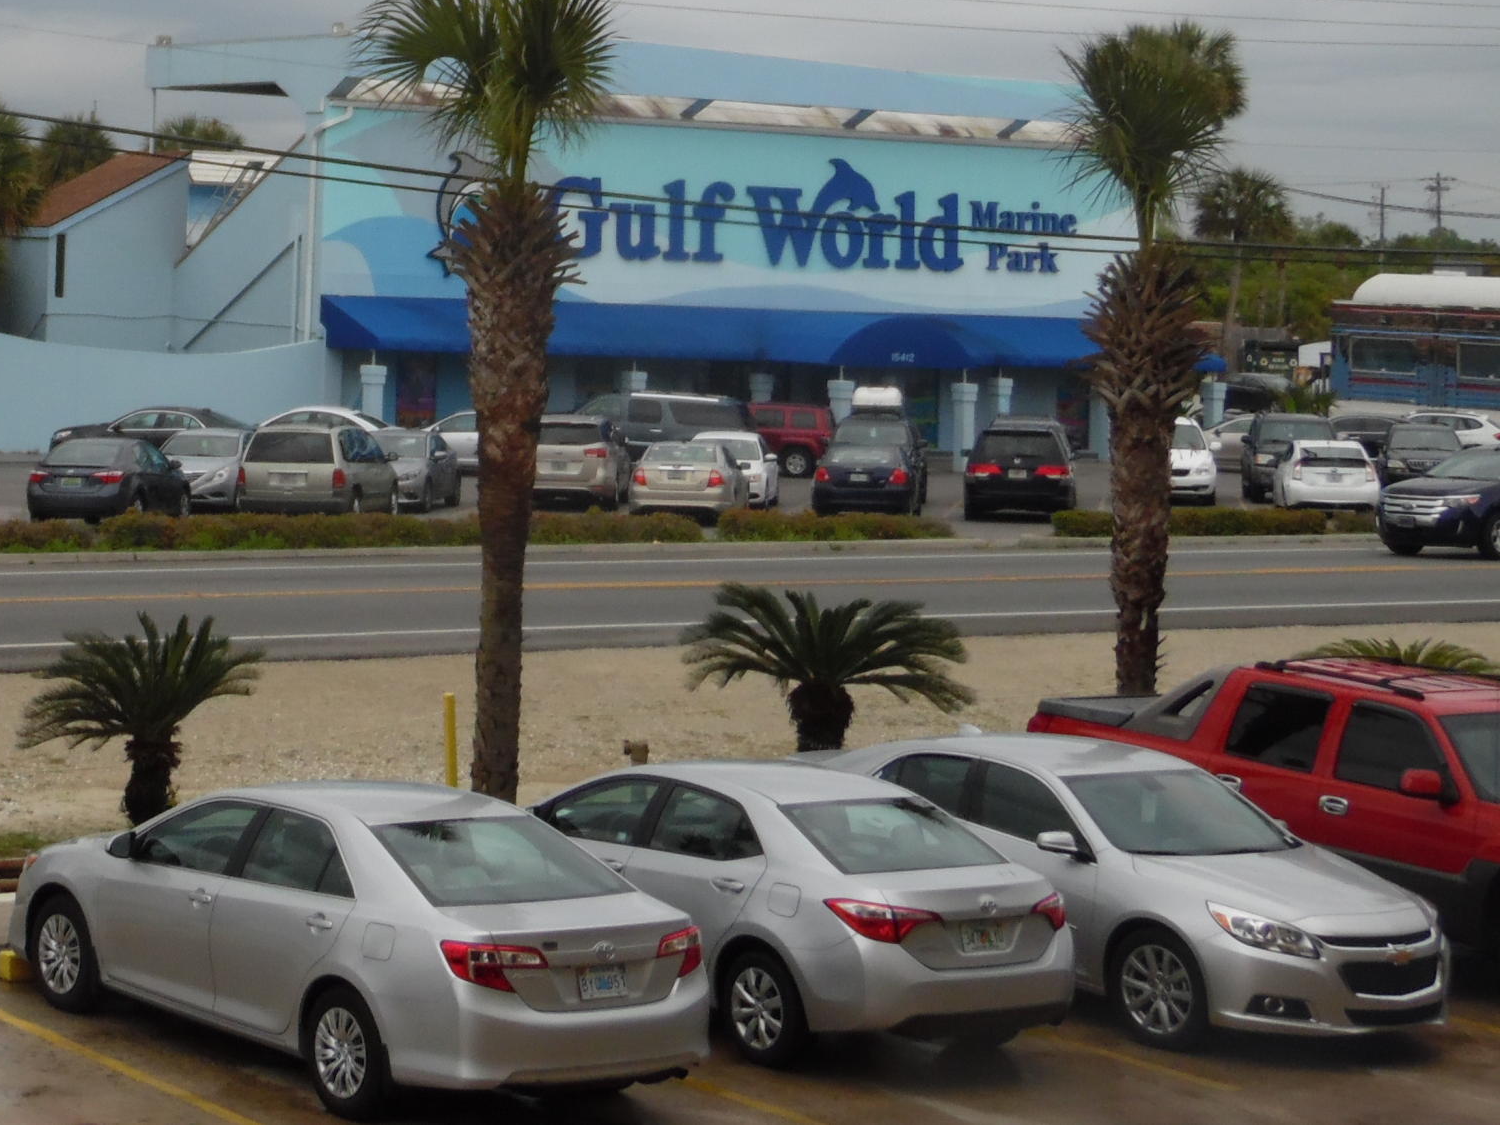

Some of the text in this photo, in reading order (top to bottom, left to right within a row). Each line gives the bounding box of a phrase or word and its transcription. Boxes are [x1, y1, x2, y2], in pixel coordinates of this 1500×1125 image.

[552, 176, 965, 273] Gulf World
[969, 200, 1078, 236] Marine
[986, 242, 1061, 273] Park
